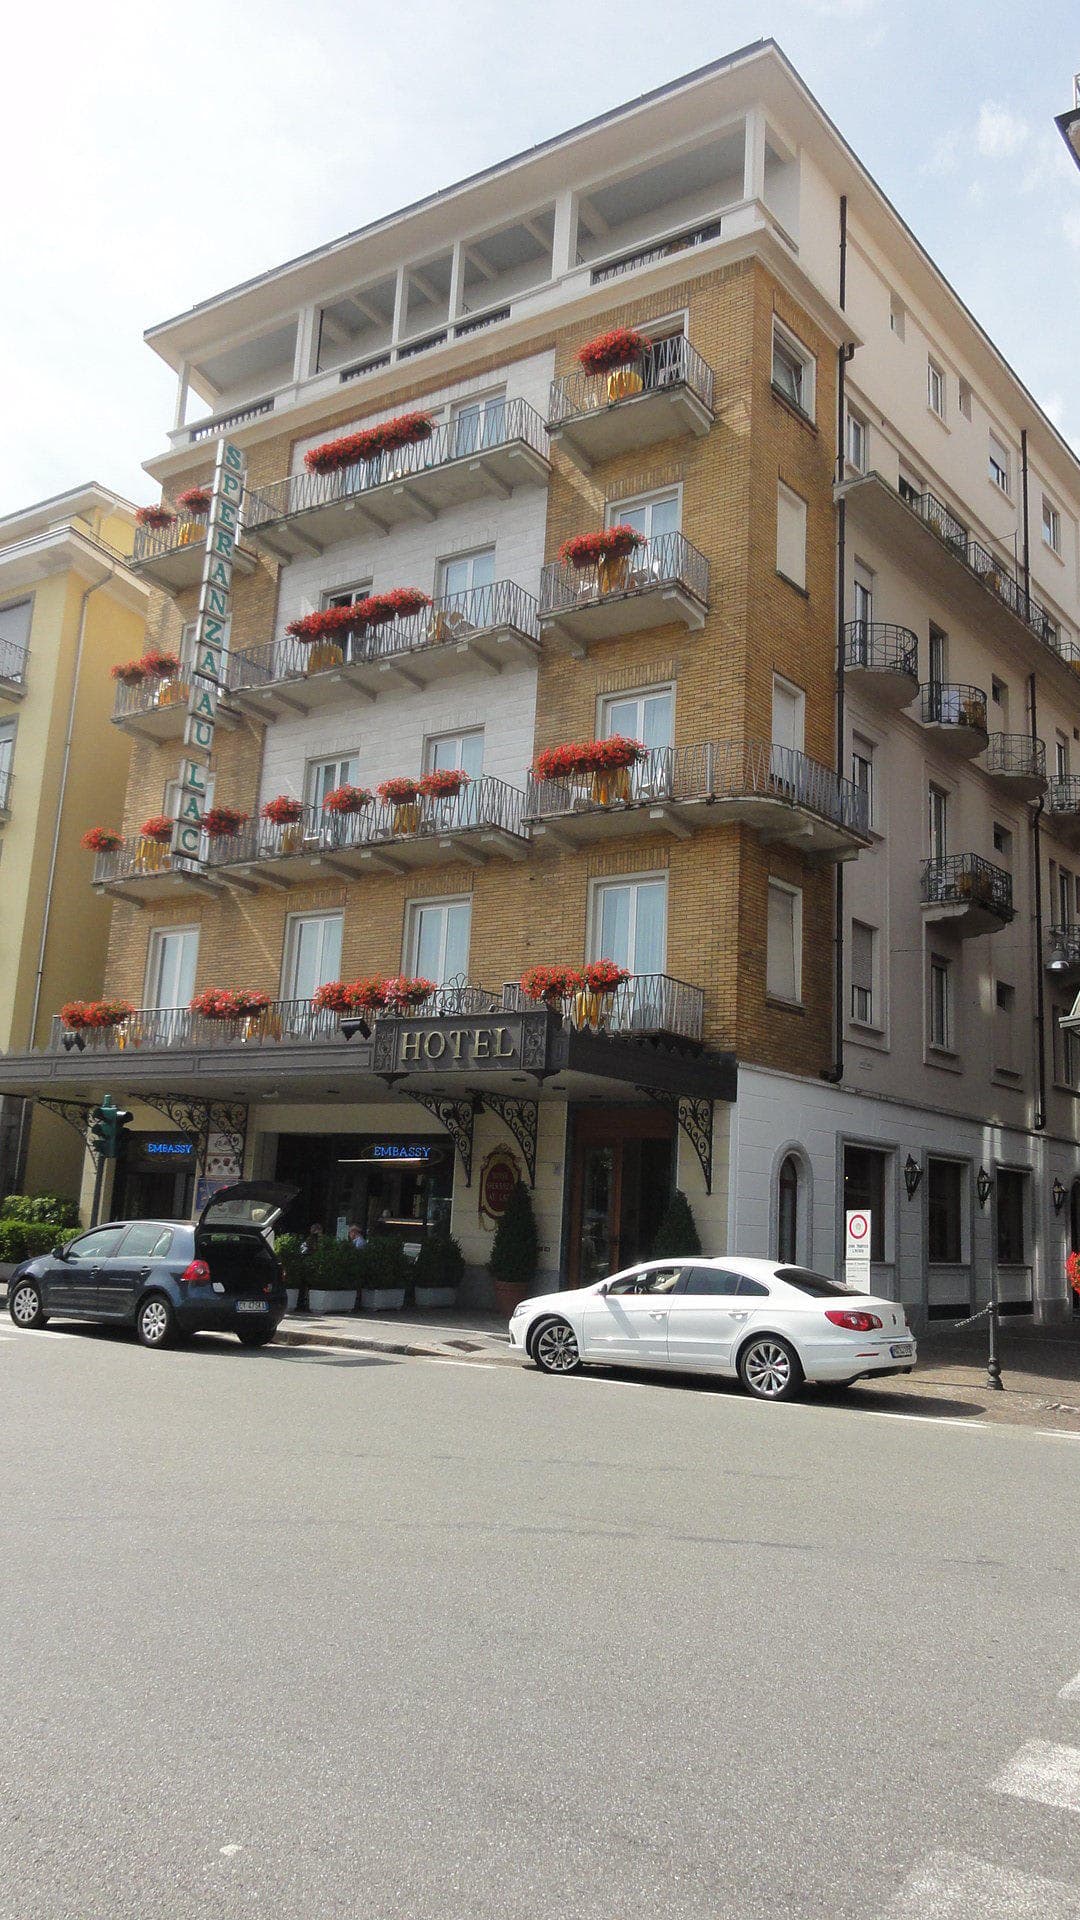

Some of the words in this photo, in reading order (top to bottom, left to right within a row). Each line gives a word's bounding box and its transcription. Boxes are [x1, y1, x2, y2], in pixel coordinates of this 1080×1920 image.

[200, 442, 242, 676] SPERANZA
[195, 693, 214, 746] AU
[181, 763, 205, 852] LAC
[400, 1027, 515, 1061] HOTEL
[147, 1143, 193, 1154] EMBASSY
[373, 1146, 431, 1158] EMBASSY
